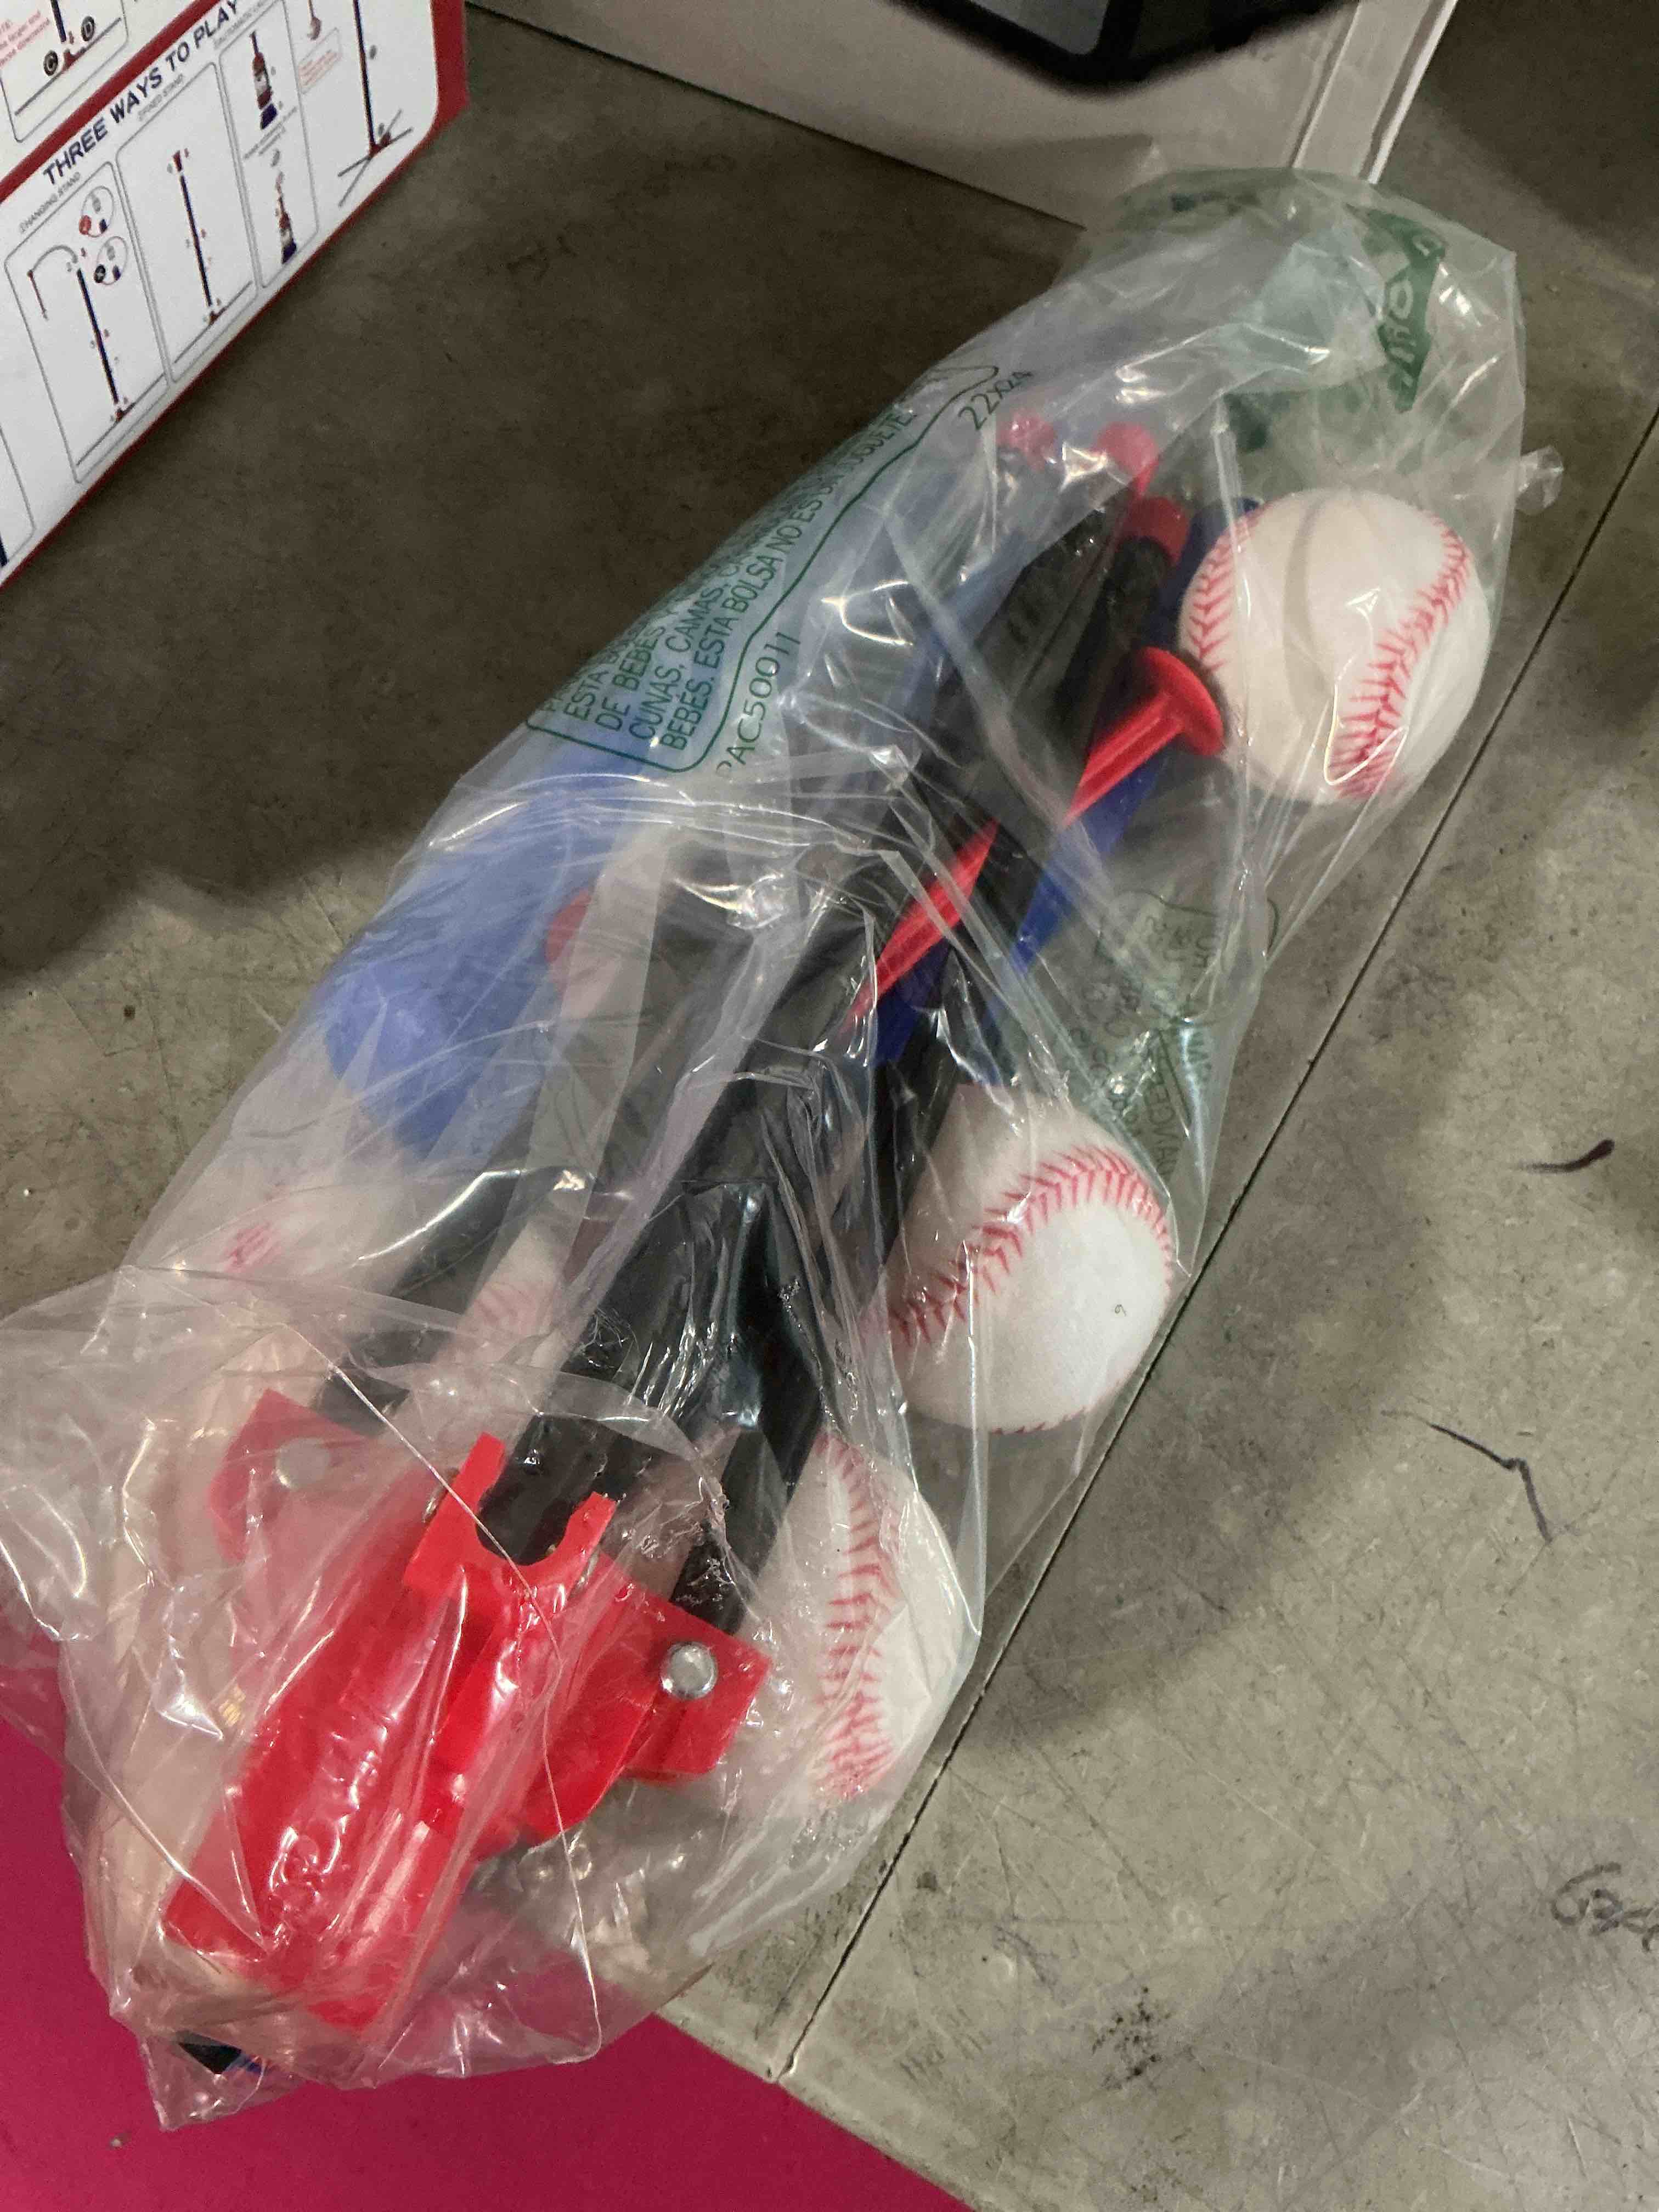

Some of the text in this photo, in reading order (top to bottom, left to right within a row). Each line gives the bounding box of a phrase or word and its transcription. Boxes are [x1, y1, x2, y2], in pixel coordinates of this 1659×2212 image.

[43, 117, 108, 184] THREE
[110, 67, 162, 123] WAYS
[166, 42, 190, 71] TO
[193, 0, 238, 48] PLAY
[693, 617, 740, 669] ESTA
[721, 555, 783, 613] BOLSA
[765, 525, 802, 554] NO
[789, 499, 823, 523] ES
[563, 669, 609, 721] ESTA
[595, 697, 631, 731] DE
